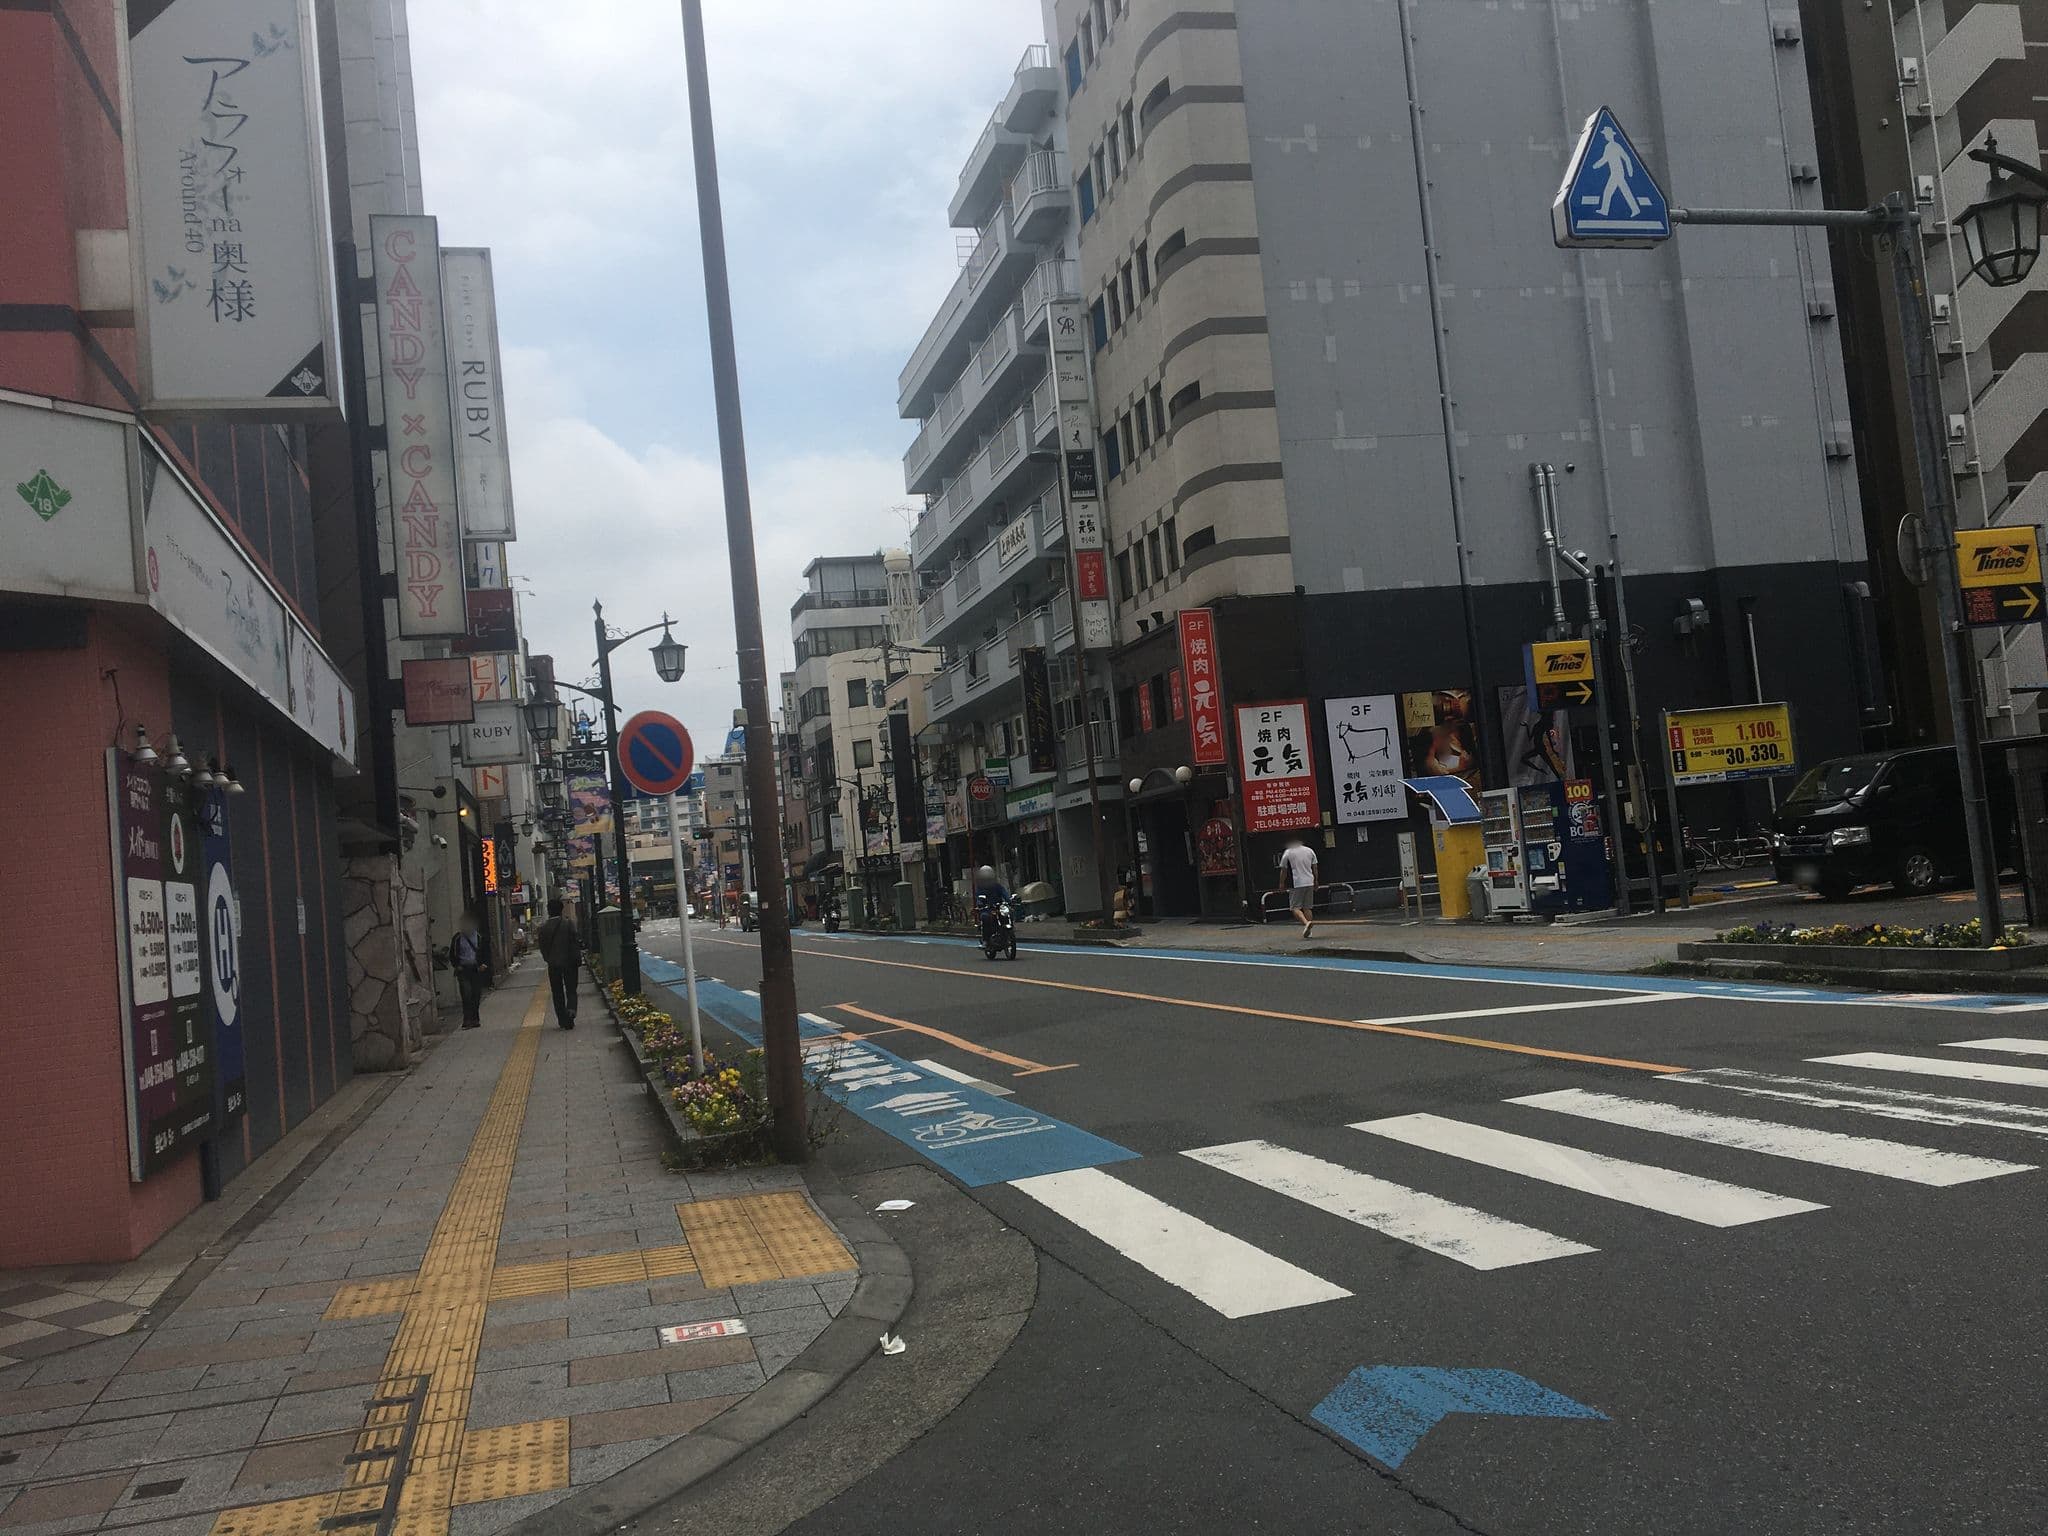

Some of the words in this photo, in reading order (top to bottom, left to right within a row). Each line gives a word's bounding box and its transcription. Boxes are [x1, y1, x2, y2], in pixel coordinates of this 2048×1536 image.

[179, 150, 203, 226] Around
[183, 228, 206, 254] 40
[385, 230, 426, 400] CANDY
[461, 359, 492, 445] RUBY
[37, 497, 53, 512] 18
[401, 444, 444, 618] CANDY
[1973, 545, 2029, 572] Times
[1189, 621, 1204, 631] 2F
[1190, 638, 1209, 675] 焼肉
[1545, 653, 1586, 672] Times
[1193, 679, 1218, 749] 元気
[1261, 711, 1283, 723] 2F
[1351, 705, 1371, 716] 3F
[472, 726, 513, 739] RUBY
[1257, 727, 1291, 743] 焼肉
[1251, 744, 1303, 776] 元気
[1342, 780, 1368, 804] 元気
[1567, 785, 1590, 798] 100
[1257, 802, 1307, 817] 駐車場完備
[1255, 820, 1268, 829] TEL
